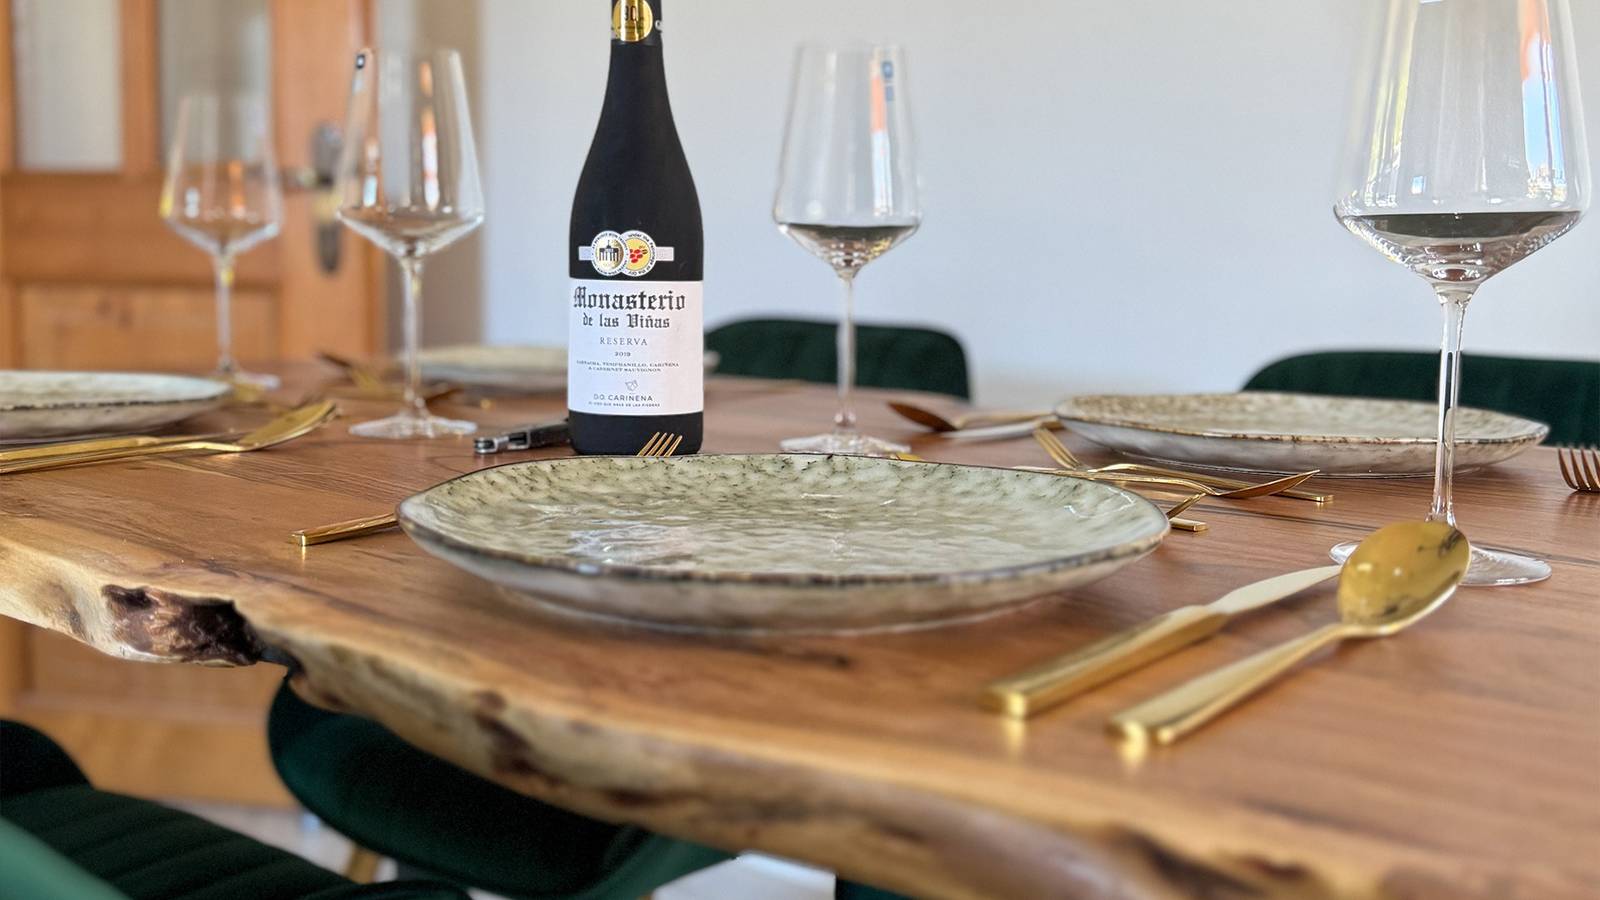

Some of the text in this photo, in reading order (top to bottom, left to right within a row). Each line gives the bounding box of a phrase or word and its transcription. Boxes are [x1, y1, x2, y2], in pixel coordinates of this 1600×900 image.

[573, 286, 686, 310] Monasterio
[582, 312, 670, 328] de las Viñas
[599, 336, 648, 346] RESERVA
